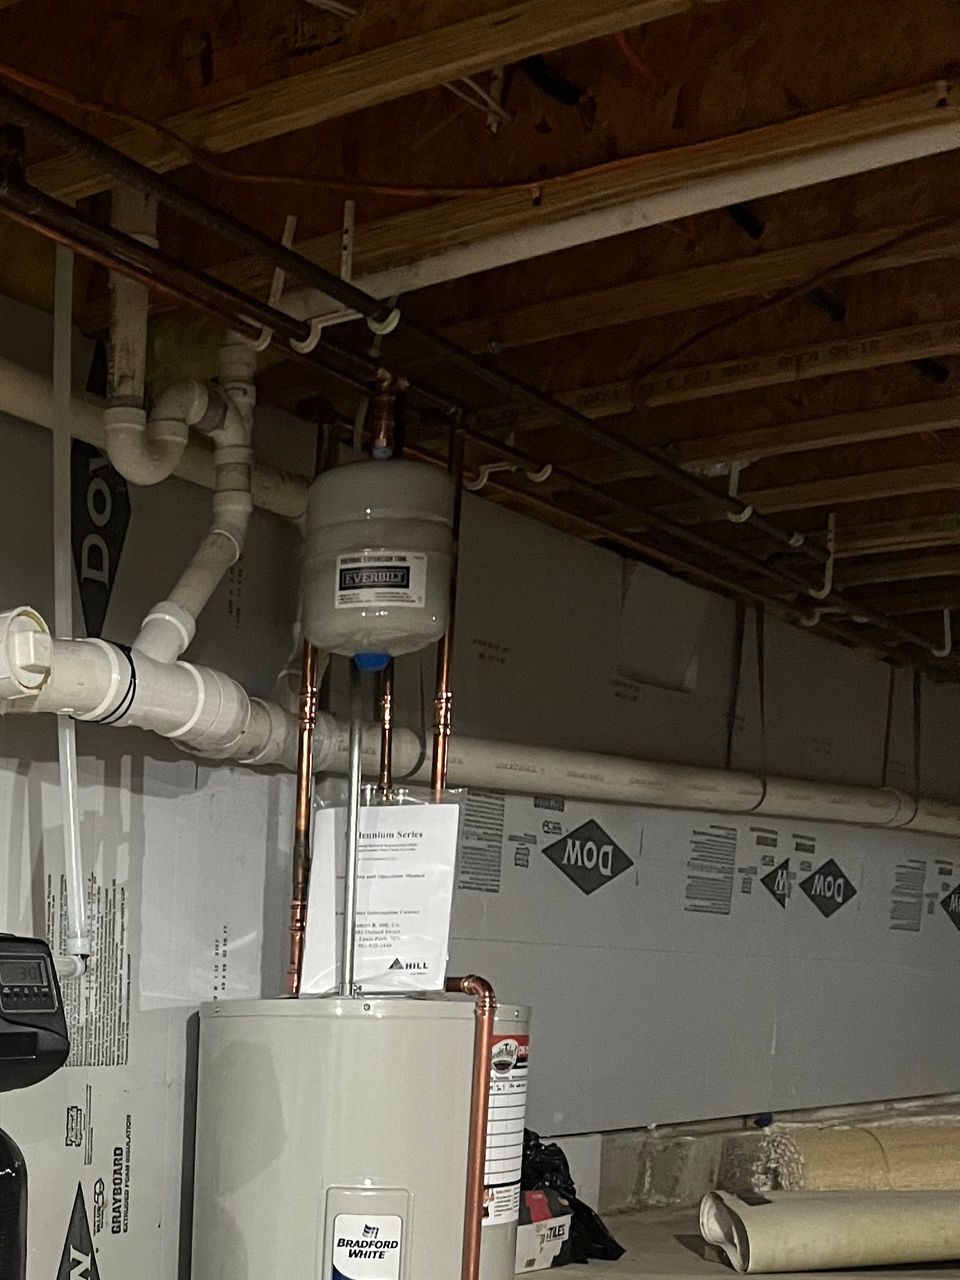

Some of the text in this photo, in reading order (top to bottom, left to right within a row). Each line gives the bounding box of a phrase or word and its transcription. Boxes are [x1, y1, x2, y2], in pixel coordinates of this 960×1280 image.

[345, 572, 404, 584] EVERBILT
[396, 831, 423, 839] Series
[563, 838, 614, 877] DOW
[811, 873, 845, 904] DOW
[112, 1147, 123, 1234] GRAYBOARD
[336, 1238, 399, 1249] BRADFORD
[348, 1249, 386, 1260] WHITE
